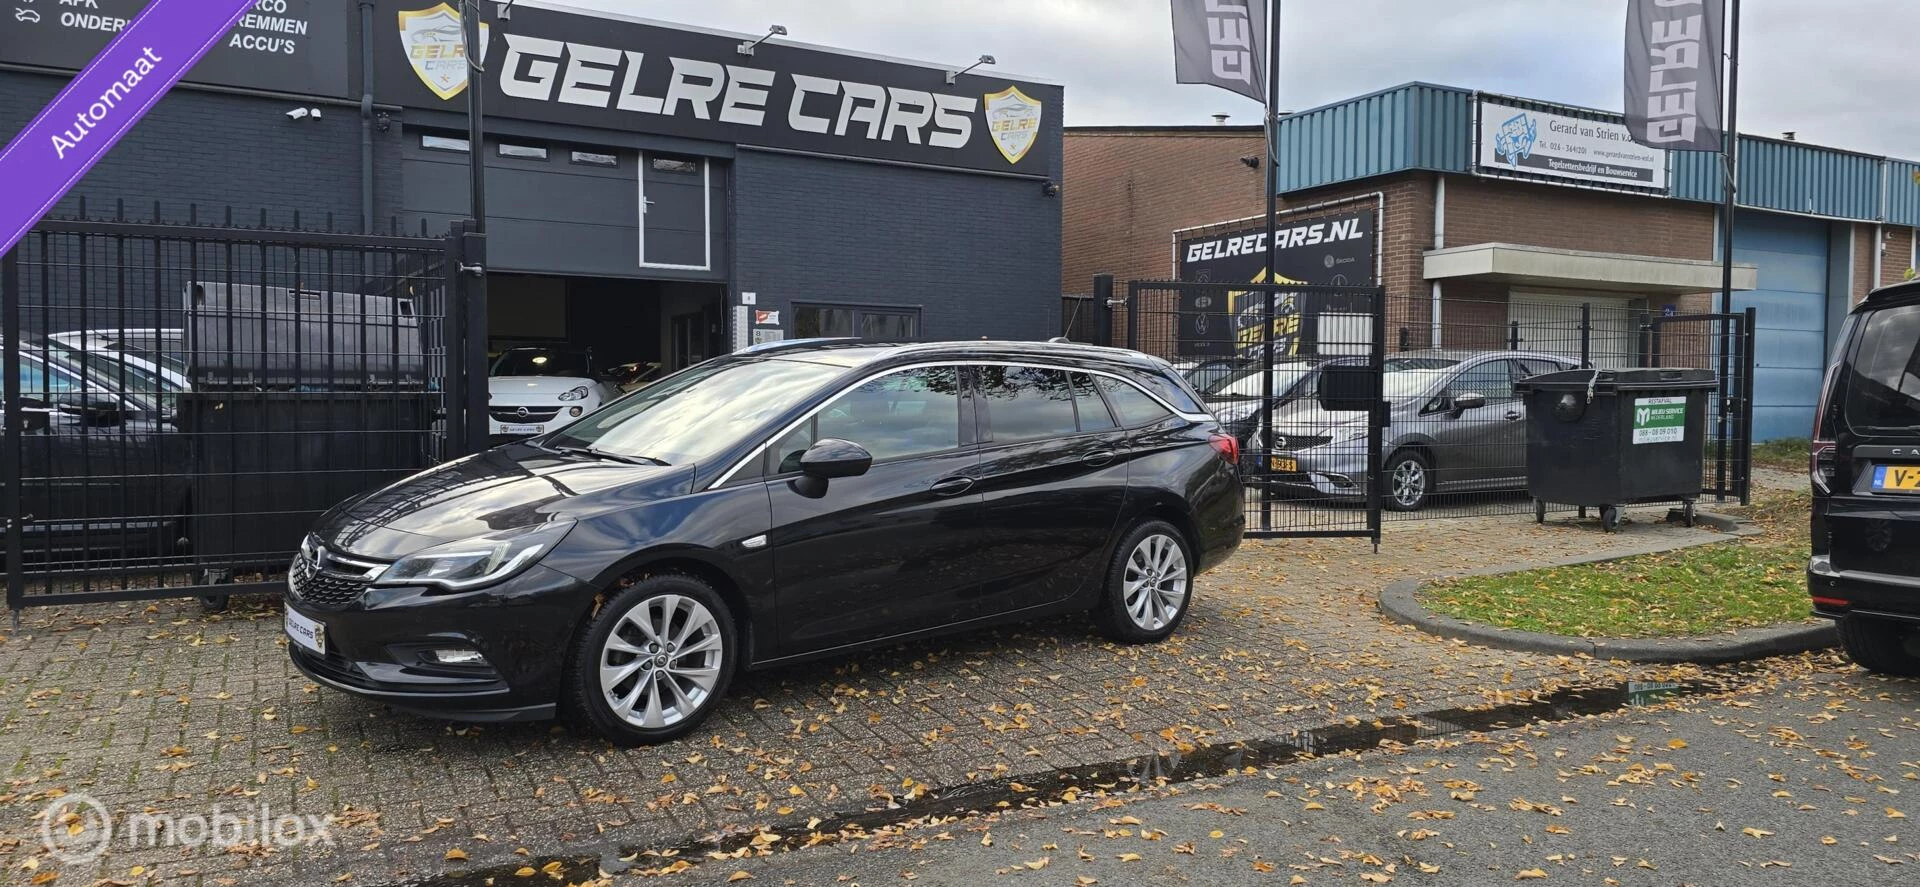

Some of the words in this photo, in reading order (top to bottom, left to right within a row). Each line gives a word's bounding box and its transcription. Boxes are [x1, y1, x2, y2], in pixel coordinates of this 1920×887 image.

[61, 12, 131, 33] ONDER
[229, 33, 296, 55] ACCU'S
[410, 44, 466, 59] GELR
[1646, 14, 1702, 143] GELRE
[500, 33, 776, 127] GELRE
[787, 73, 978, 149] CARS
[991, 117, 1037, 133] GELRE
[1549, 120, 1578, 135] Gerard
[1580, 127, 1594, 138] van
[1596, 127, 1619, 141] Strien
[1186, 217, 1364, 263] GELRECARS.NL
